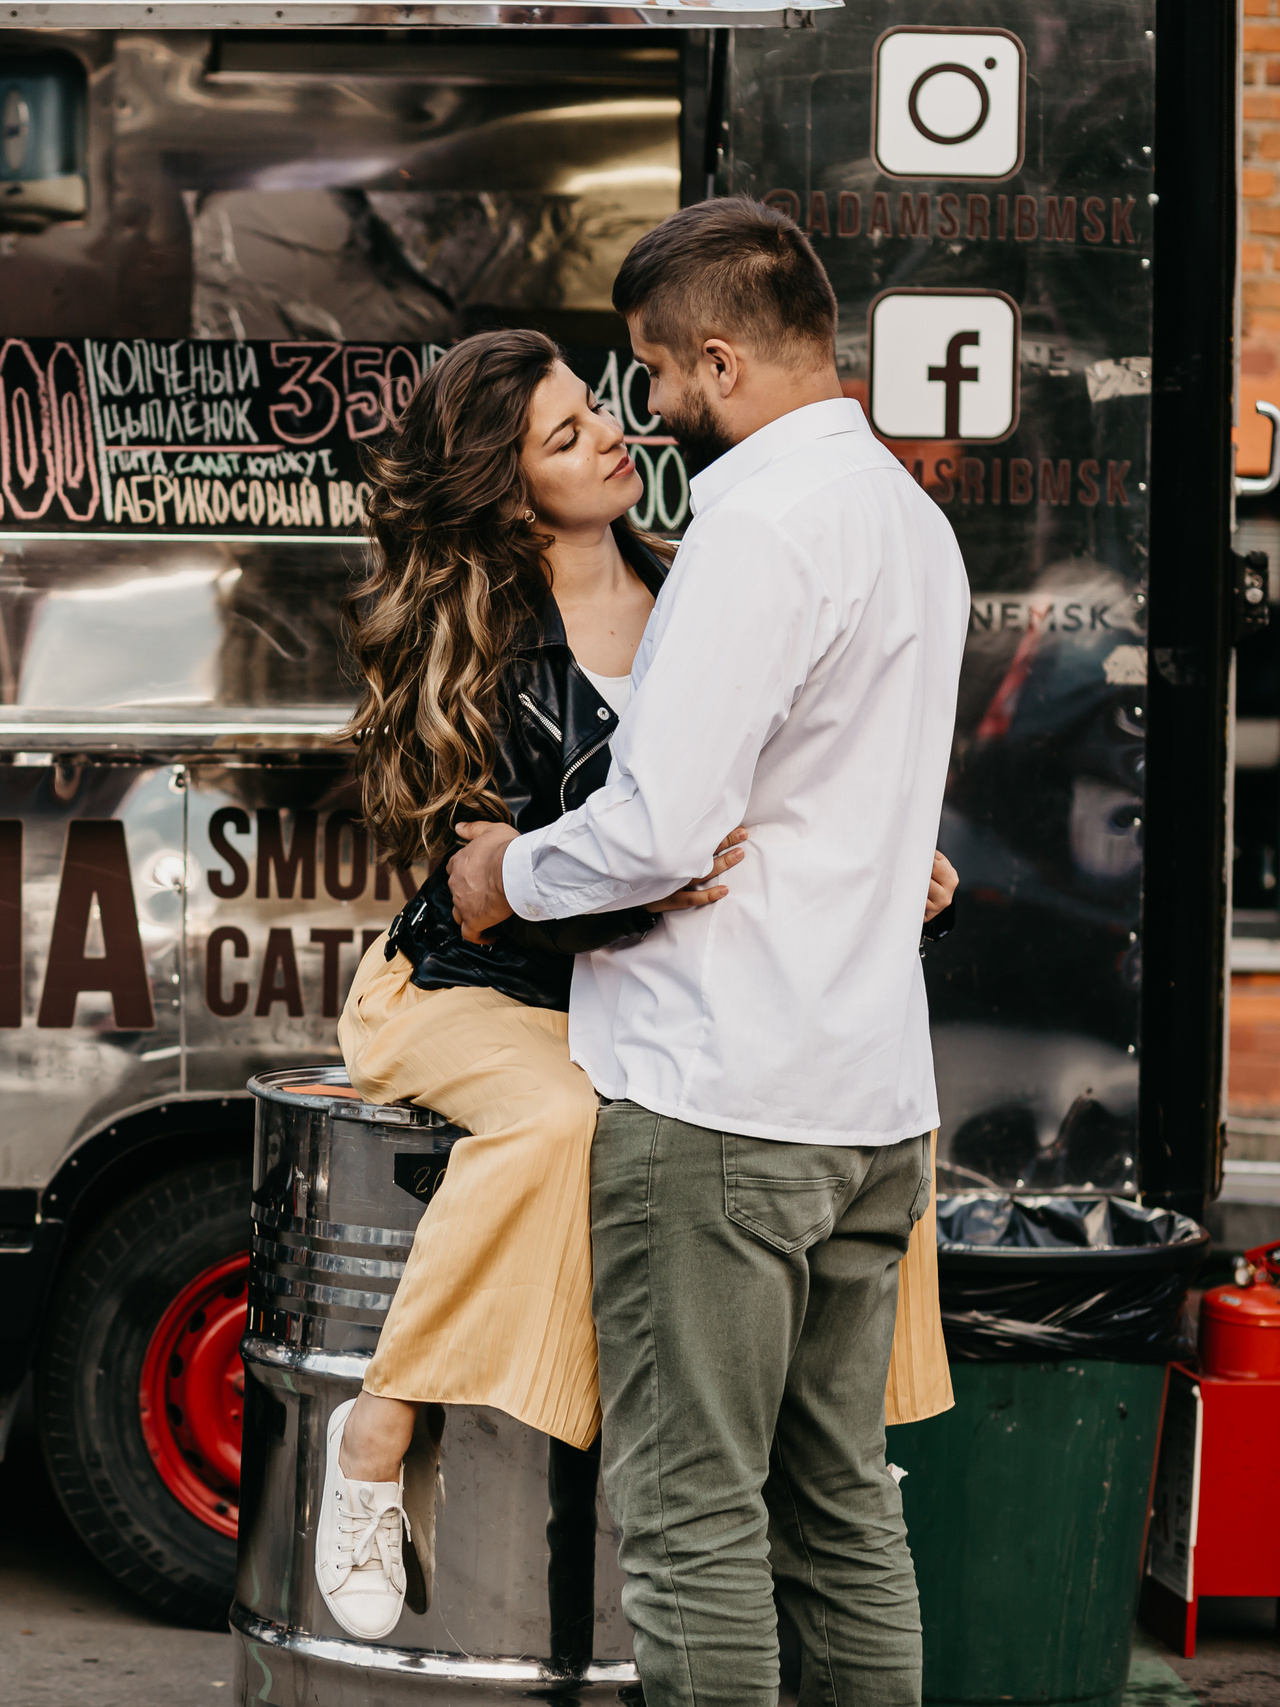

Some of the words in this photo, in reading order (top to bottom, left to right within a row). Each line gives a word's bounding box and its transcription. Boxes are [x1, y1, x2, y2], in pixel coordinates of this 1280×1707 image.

[93, 339, 260, 397] КОПЧЕНЫЙ
[269, 341, 421, 444] 350
[103, 392, 259, 446] ЦЫПЛЁНОК
[115, 474, 324, 527] АБРИКОСОВЫЙ
